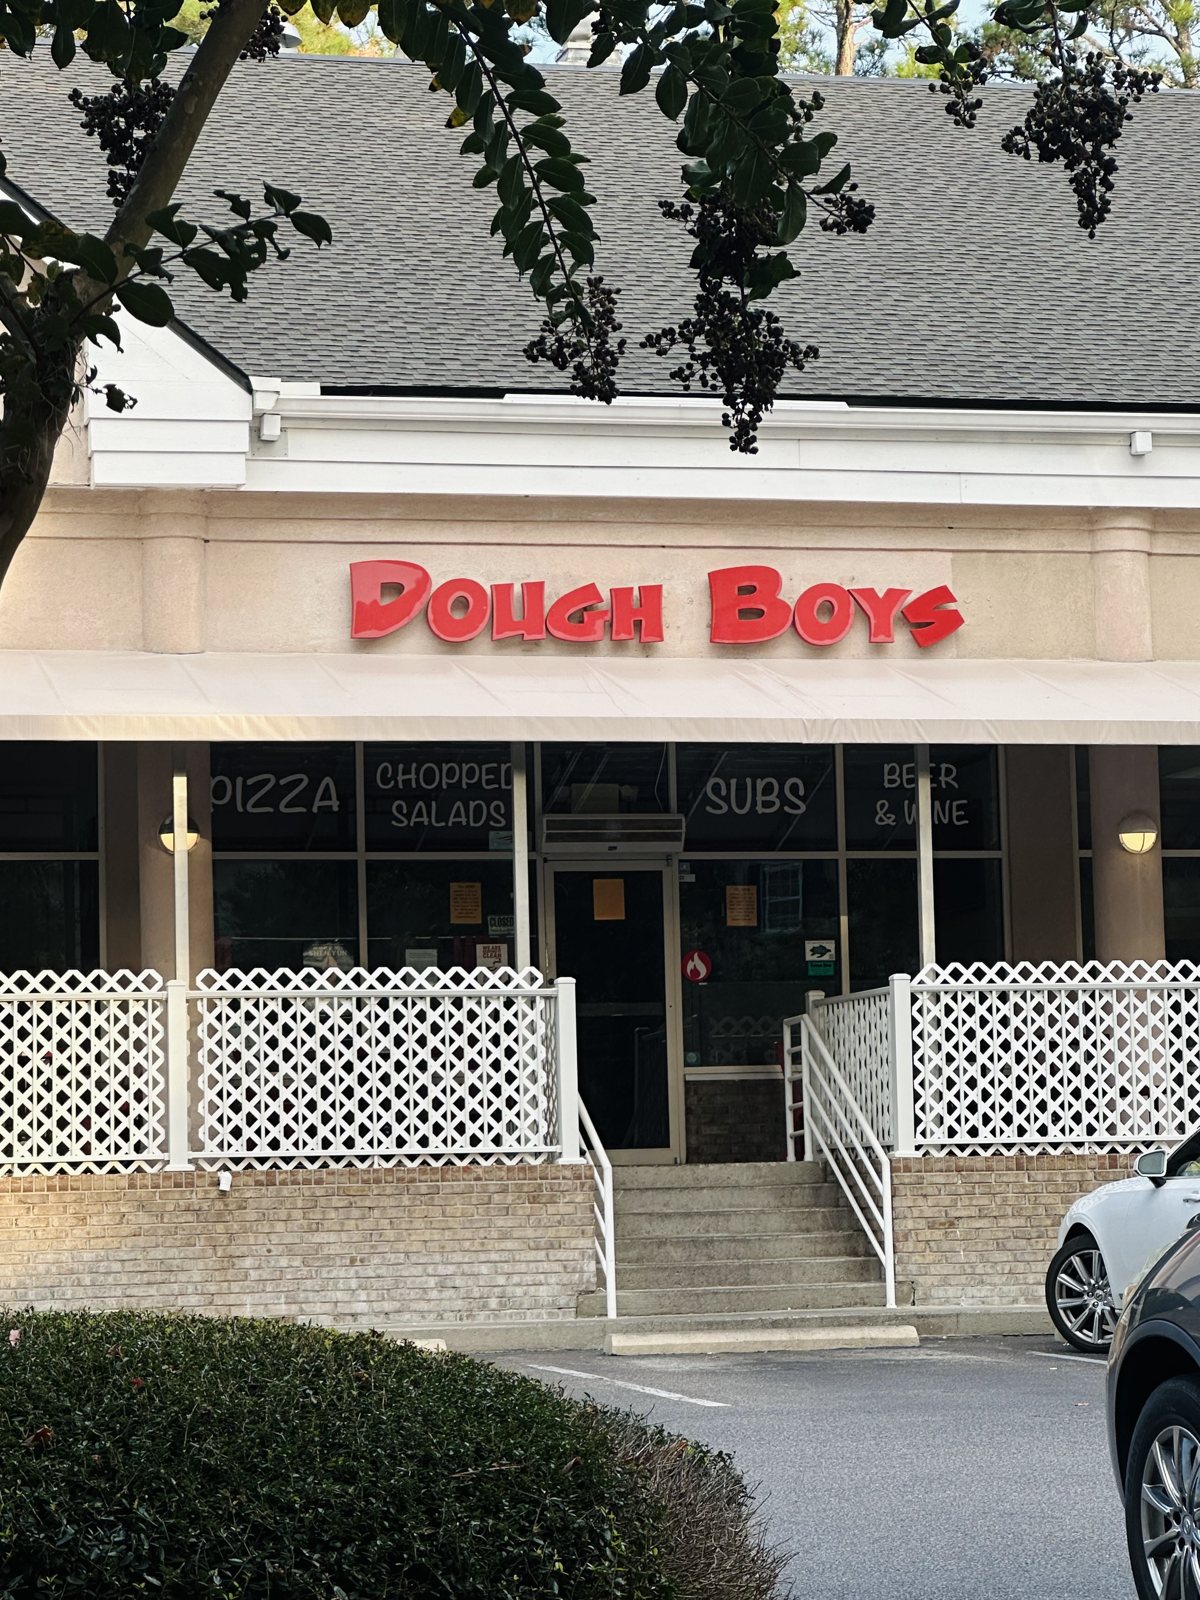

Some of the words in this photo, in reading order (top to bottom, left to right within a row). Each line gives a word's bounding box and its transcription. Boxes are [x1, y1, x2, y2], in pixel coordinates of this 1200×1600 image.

[350, 559, 663, 644] DOUGH
[708, 565, 965, 649] BOYS
[376, 762, 512, 790] CHOPPED
[210, 773, 340, 815] PIZZA
[705, 777, 808, 815] SUBS
[391, 800, 507, 828] SALADS
[874, 799, 897, 826] &
[903, 799, 970, 826] WNE
[489, 916, 515, 928] CLOSED
